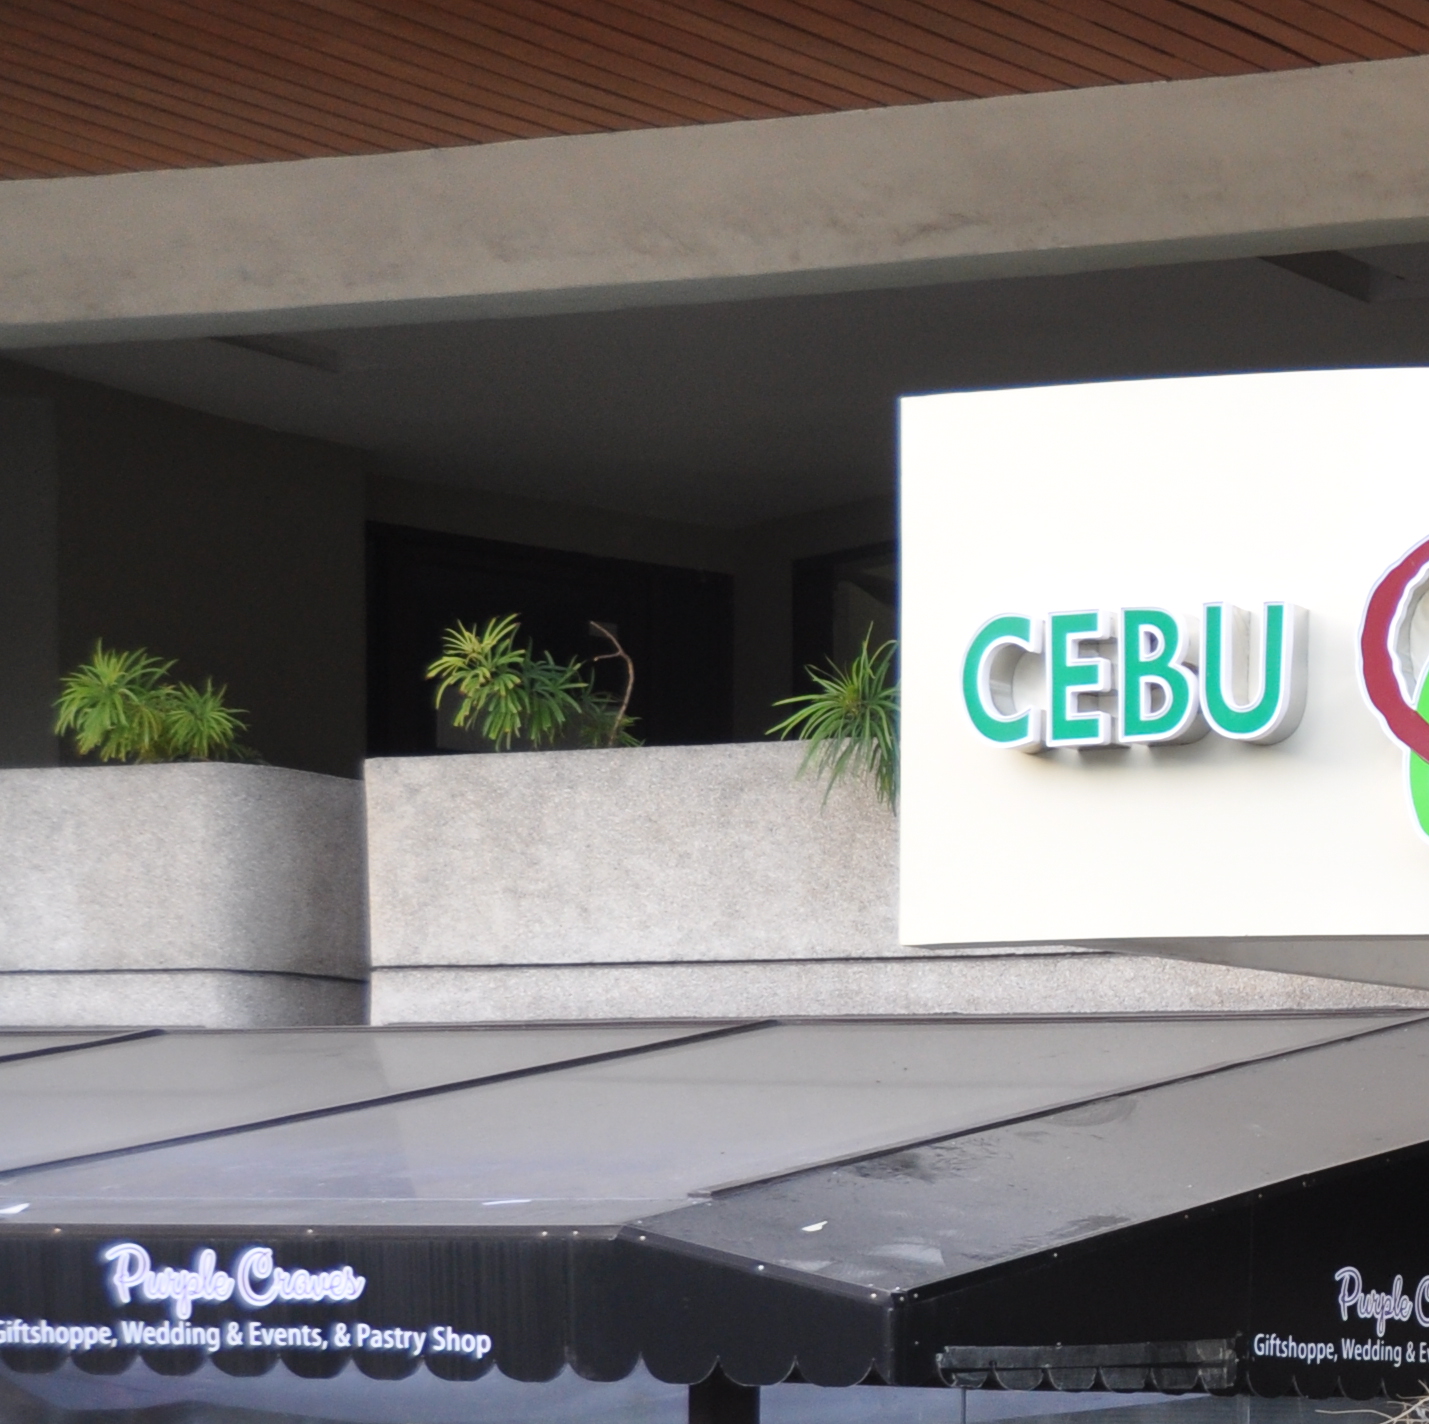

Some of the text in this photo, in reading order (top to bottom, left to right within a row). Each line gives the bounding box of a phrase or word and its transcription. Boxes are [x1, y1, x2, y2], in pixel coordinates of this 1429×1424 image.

[960, 600, 1304, 751] CEBU
[105, 1242, 366, 1320] Purple Craves
[1334, 1266, 1413, 1337] Purple
[121, 1320, 221, 1352] Wedding
[226, 1321, 243, 1346] &
[249, 1322, 328, 1350] Events,
[334, 1323, 351, 1348] &
[357, 1324, 427, 1356] Pastry
[432, 1326, 492, 1358] Shop
[1253, 1333, 1338, 1365] Giftshoppe,
[1341, 1337, 1403, 1368] Wedding
[1405, 1341, 1415, 1363] &
